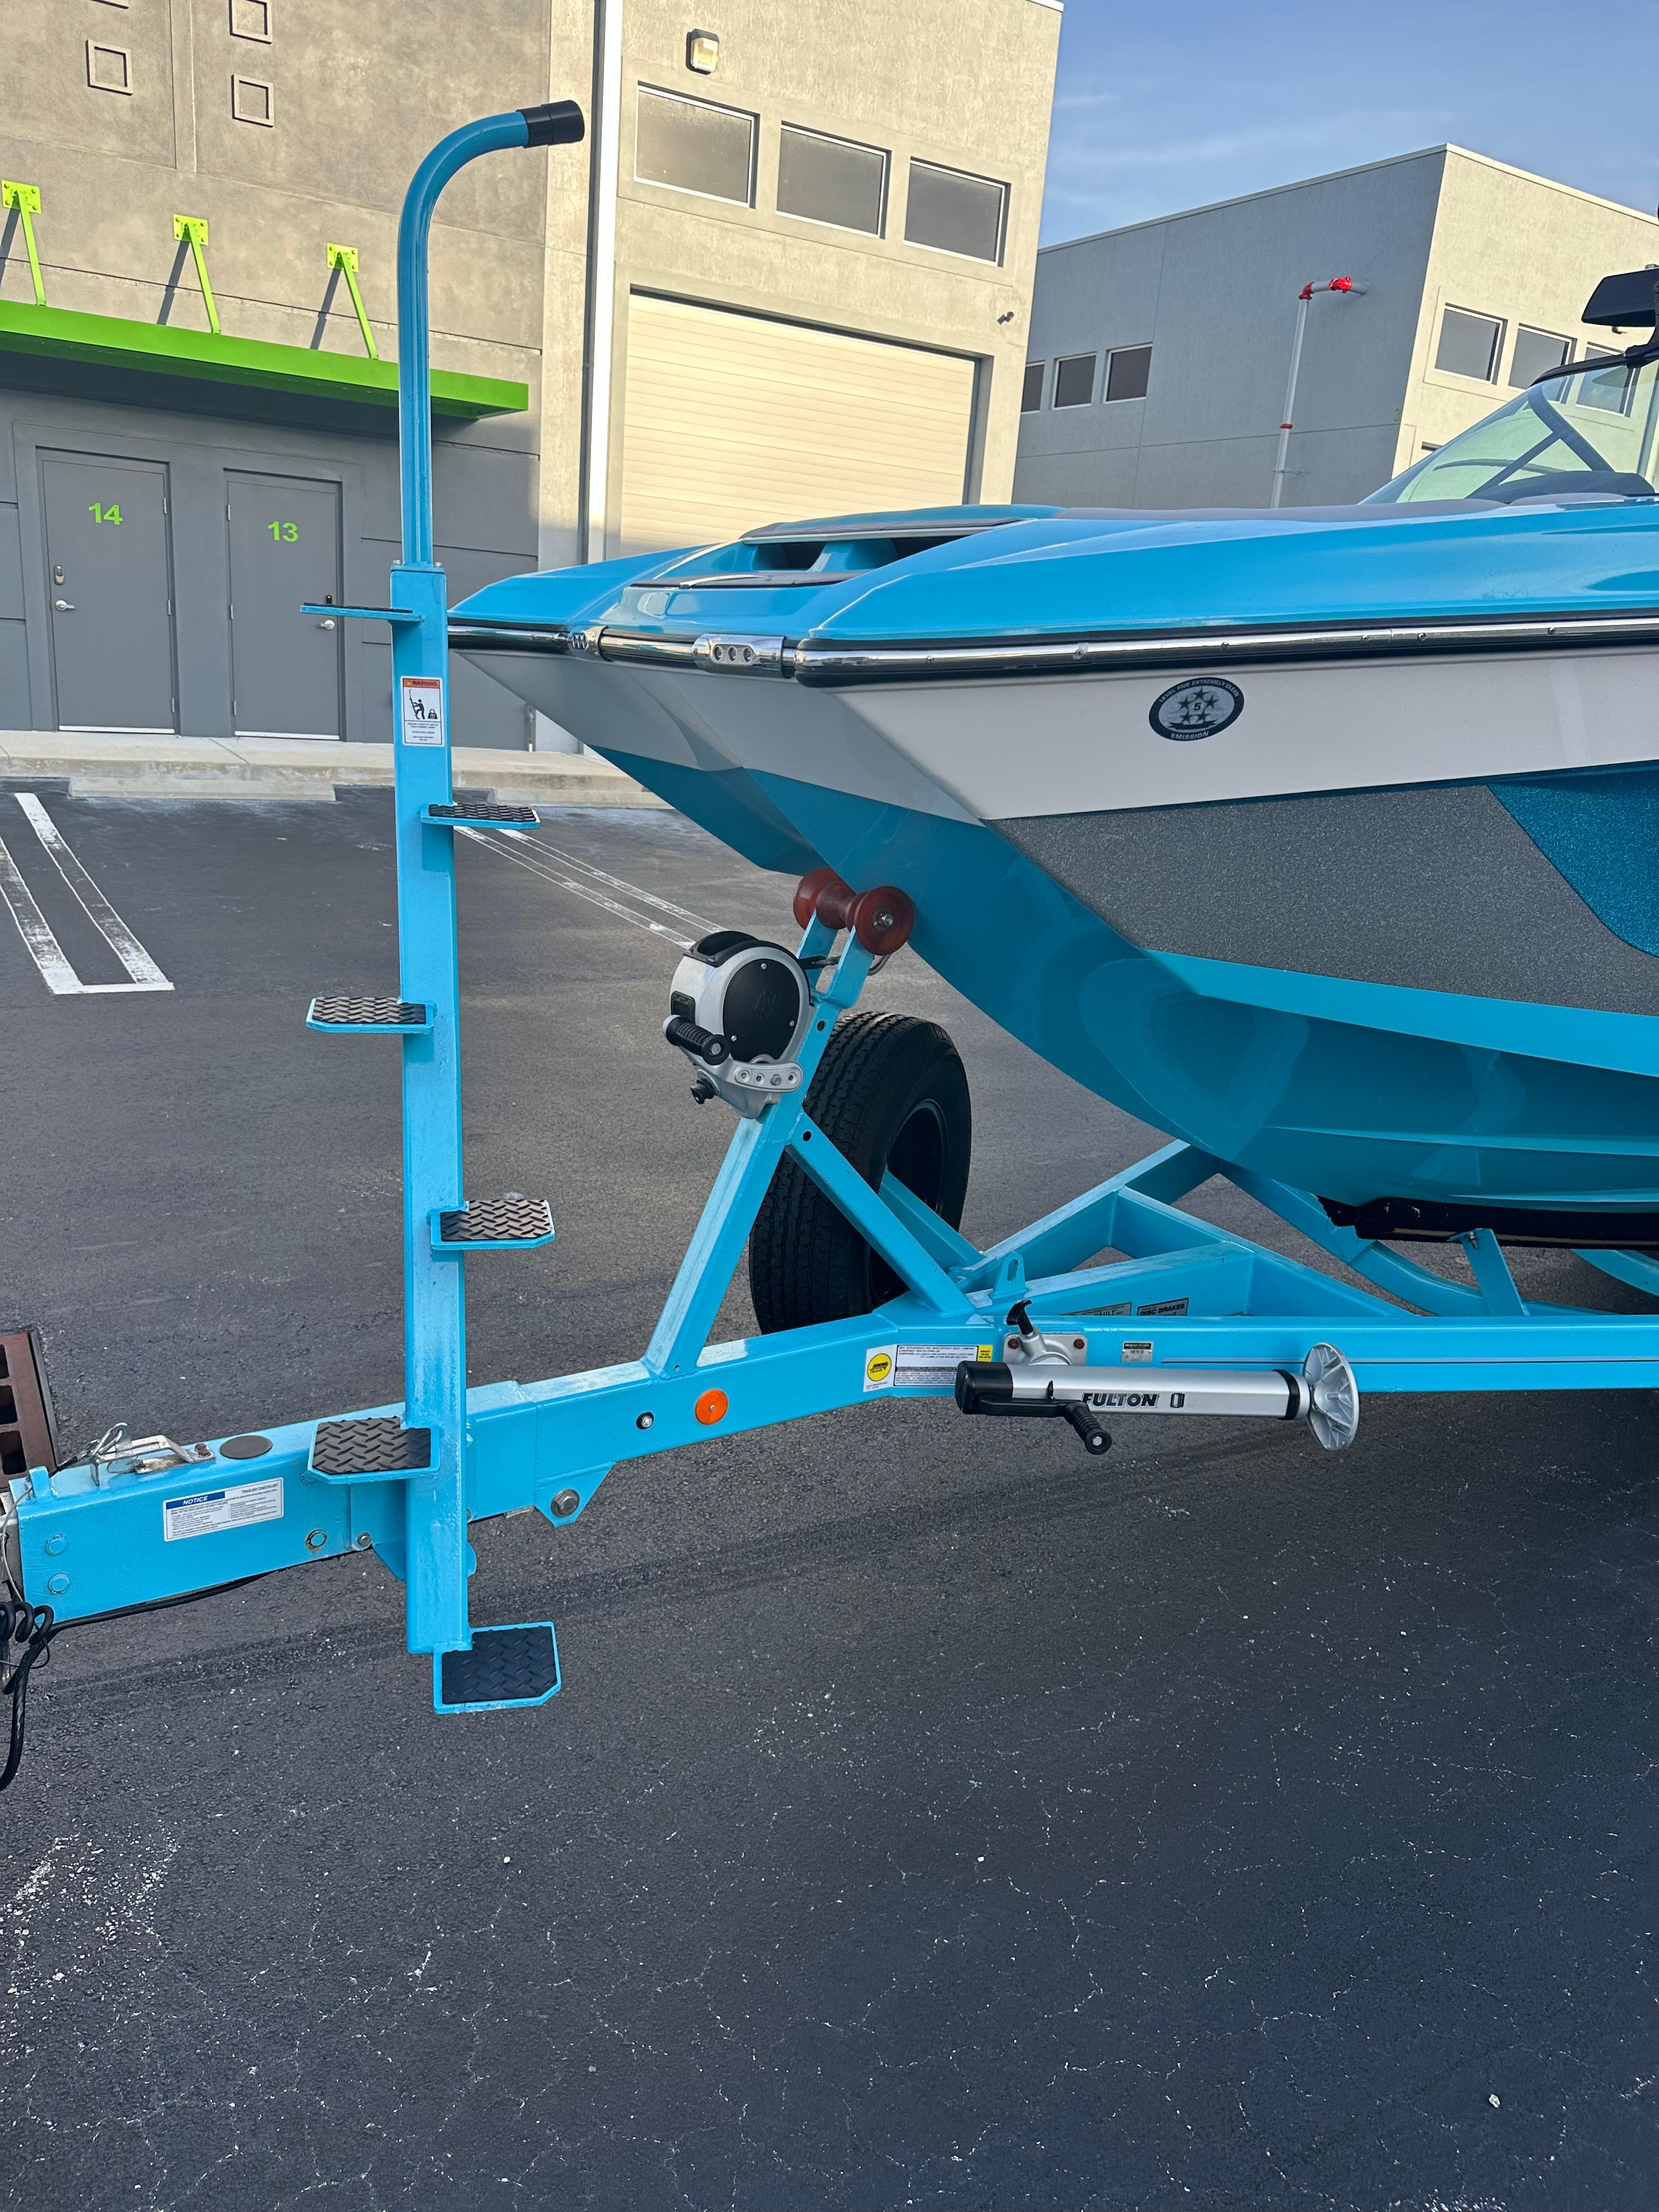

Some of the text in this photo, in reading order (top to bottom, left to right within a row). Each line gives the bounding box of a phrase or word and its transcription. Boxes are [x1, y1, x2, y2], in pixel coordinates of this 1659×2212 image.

[88, 502, 123, 526] 14
[268, 521, 299, 543] 13
[1159, 689, 1176, 703] LEVEL
[1177, 682, 1190, 690] FIVE
[1225, 684, 1240, 697] CLEAN
[1170, 731, 1209, 740] EMISSION
[1158, 1303, 1185, 1313] BRAKES
[1082, 1393, 1158, 1407] FULTON
[183, 1496, 209, 1505] NOTICE
